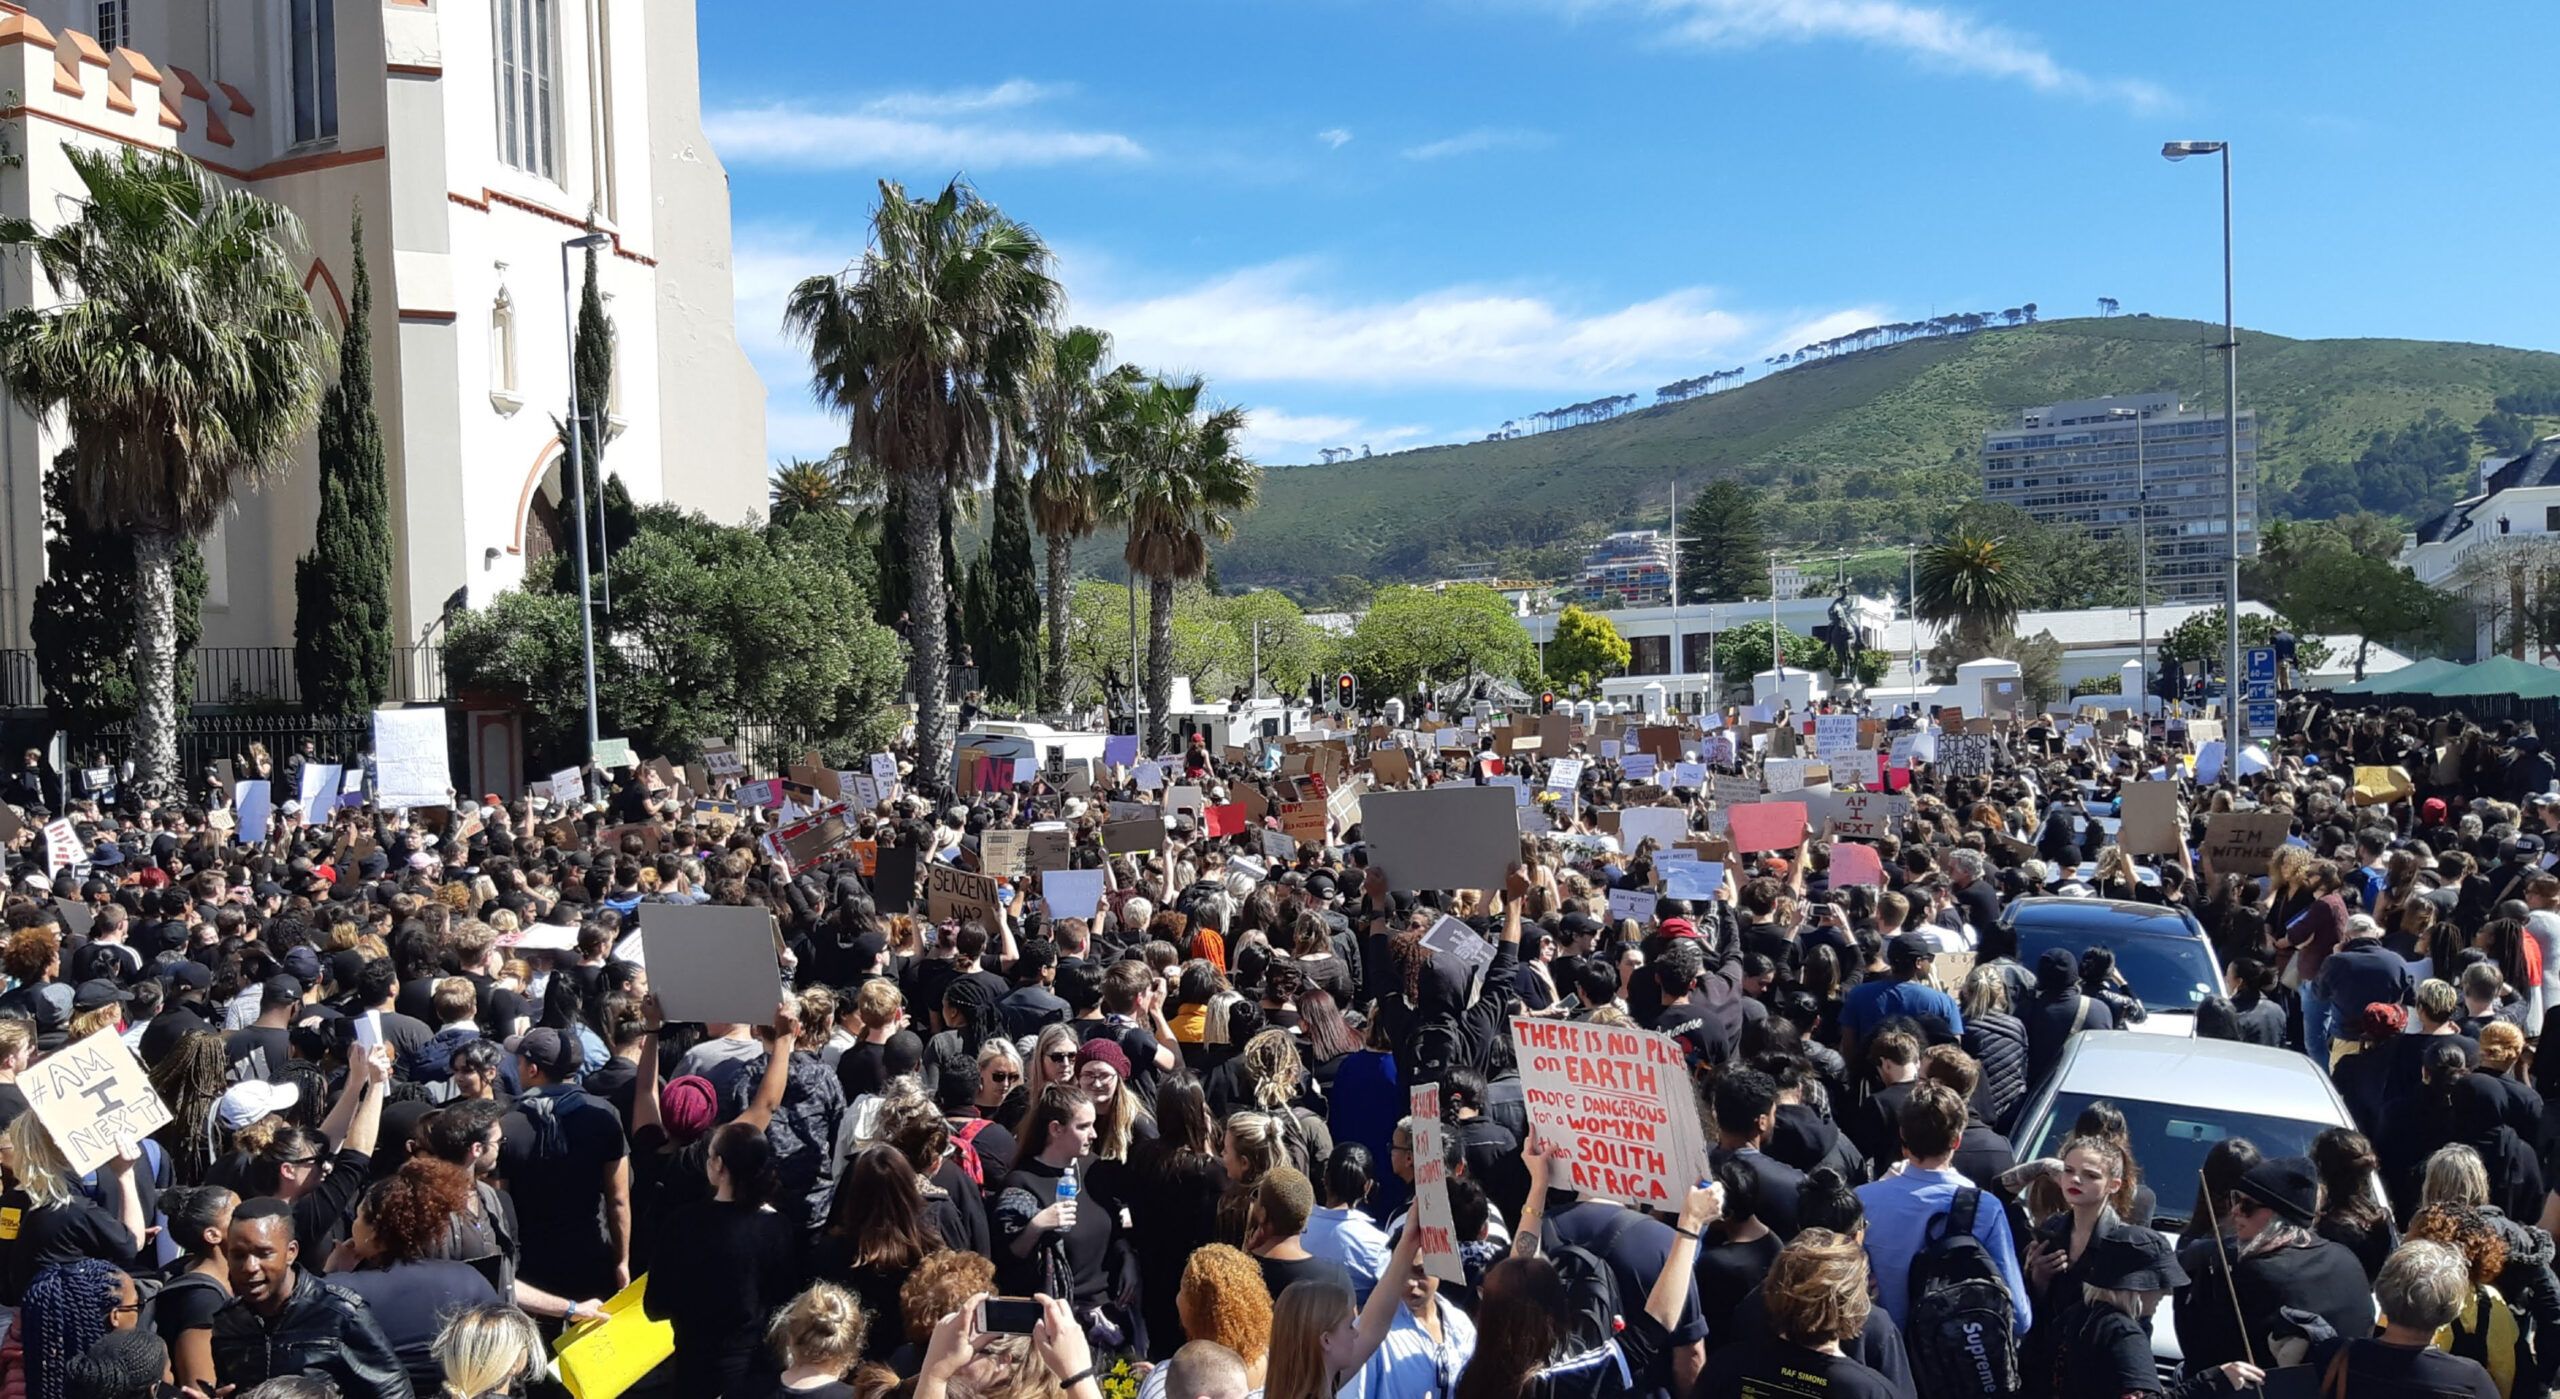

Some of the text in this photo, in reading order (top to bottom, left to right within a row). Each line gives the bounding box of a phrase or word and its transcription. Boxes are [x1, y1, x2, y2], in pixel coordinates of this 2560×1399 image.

[2254, 652, 2268, 666] P
[1046, 772, 1070, 784] NEXT
[1845, 796, 1868, 807] AM
[1849, 808, 1864, 820] I
[1834, 821, 1874, 834] NEXT
[1513, 1022, 1580, 1053] THERE
[1584, 1030, 1602, 1053] IS
[1607, 1033, 1639, 1056] NO
[1565, 1056, 1657, 1095] EARTH
[80, 1076, 125, 1117] I
[1583, 1095, 1668, 1124] DANGEROUS
[68, 1086, 166, 1162] NEXT?
[1532, 1106, 1656, 1142] for a WOMXN
[1577, 1136, 1666, 1176] SOUTH
[1571, 1162, 1668, 1200] AFRICA
[1962, 1322, 1997, 1393] Supreme
[1780, 1367, 1828, 1387] RAF SIMONS
